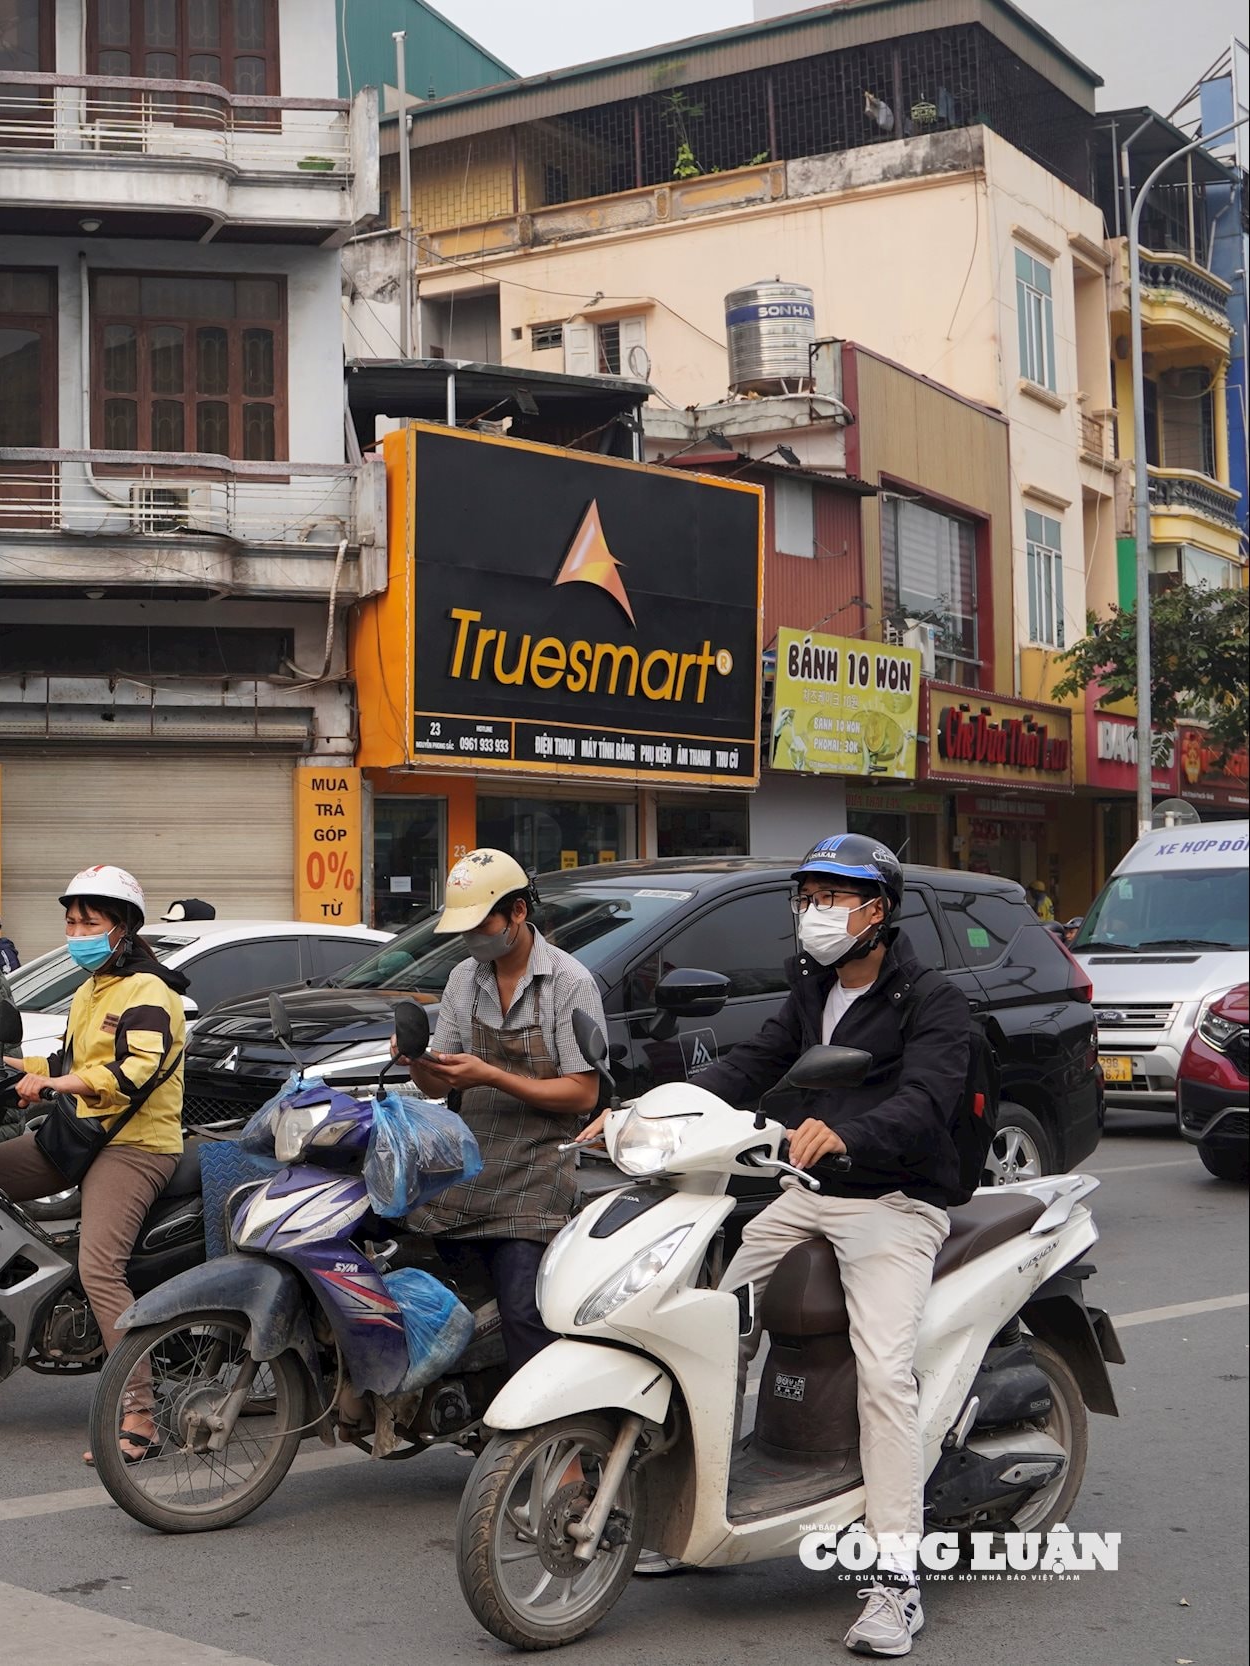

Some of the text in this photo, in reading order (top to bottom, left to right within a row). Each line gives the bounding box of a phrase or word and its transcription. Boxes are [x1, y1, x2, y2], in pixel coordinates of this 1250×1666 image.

[787, 636, 912, 692] BÁNH 10 WON
[430, 722, 441, 736] 23
[459, 737, 509, 754] 0961 933 933
[534, 732, 553, 758] ĐIỆN
[554, 737, 576, 761] THOẠI
[581, 736, 599, 759] MÁY
[599, 737, 615, 760] TÍNH
[616, 737, 635, 762] BẢNG
[640, 744, 655, 767] PHỤ
[655, 742, 672, 768] KIỆN
[676, 743, 688, 766] ÂM
[689, 748, 711, 767] THANH
[715, 750, 729, 768] THU
[311, 778, 349, 791] MUA
[314, 798, 345, 817] TRẢ
[314, 825, 347, 842] GÓP
[453, 845, 466, 858] 23
[1154, 840, 1218, 857] XE HỢP
[306, 851, 355, 892] 0%
[321, 899, 343, 917] TỪ
[333, 1262, 359, 1273] SYM
